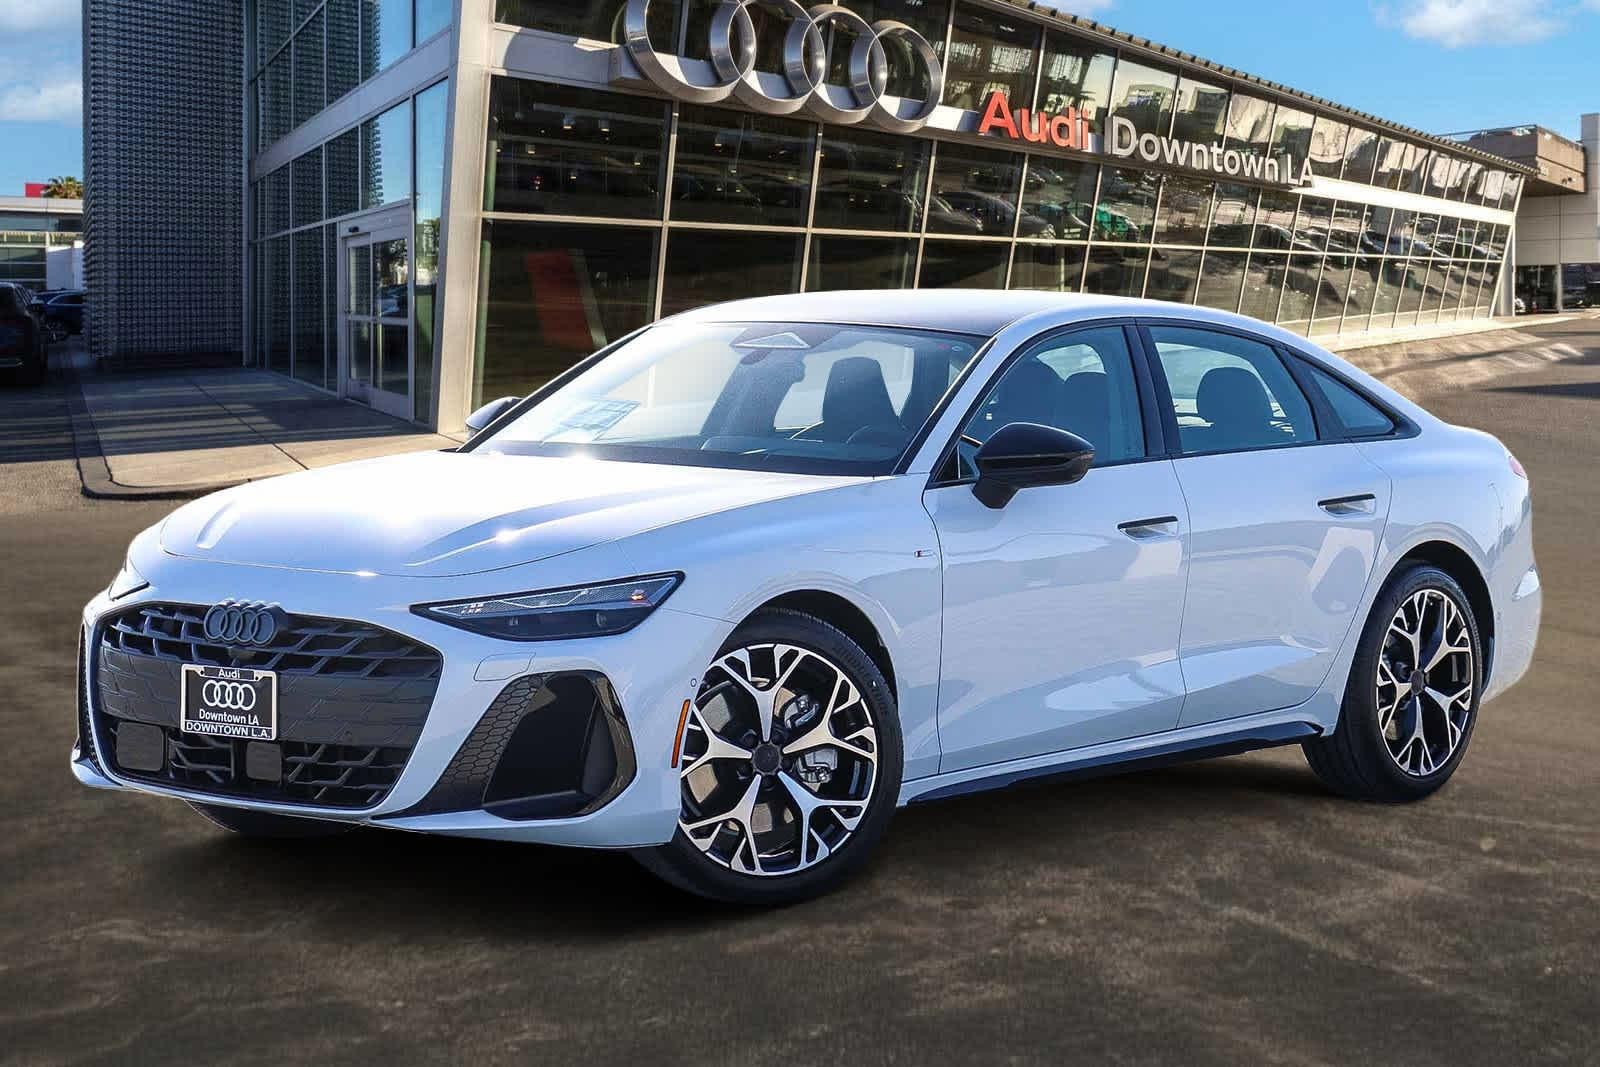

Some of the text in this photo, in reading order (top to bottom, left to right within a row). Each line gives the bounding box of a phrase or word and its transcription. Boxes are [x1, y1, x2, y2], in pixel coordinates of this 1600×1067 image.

[978, 89, 1315, 189] Audi Downtown LA
[218, 668, 240, 678] Audi
[199, 708, 260, 726] Downtown LA
[186, 721, 271, 739] DOWNTOWN L.A.
